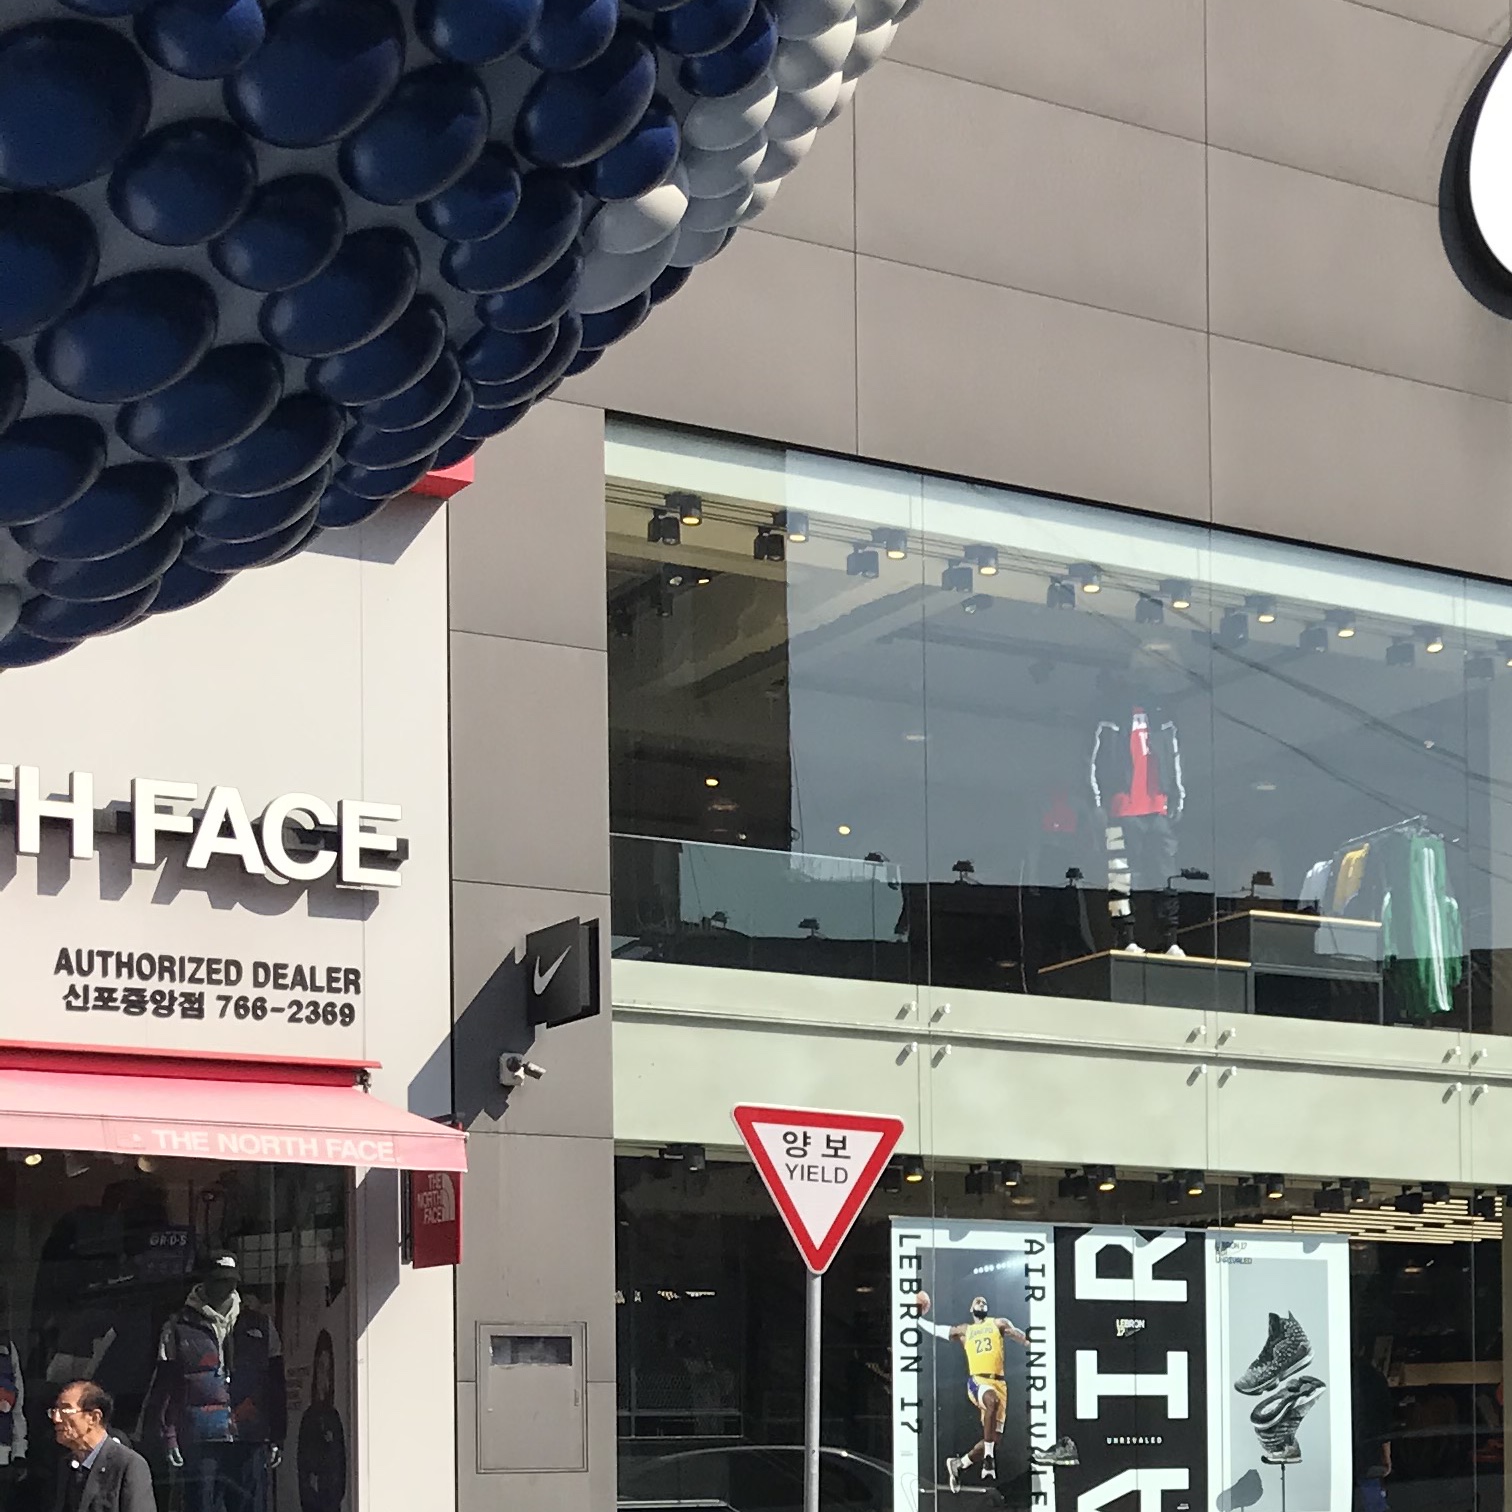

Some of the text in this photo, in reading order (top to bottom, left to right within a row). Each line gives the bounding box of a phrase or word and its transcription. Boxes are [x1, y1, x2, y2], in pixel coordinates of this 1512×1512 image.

[0, 763, 403, 888] H FACE
[54, 947, 361, 995] AUTHORIZED DEALER
[62, 984, 356, 1027] 신포중앙점 766-2369
[152, 1129, 209, 1152] THE
[218, 1133, 318, 1158] NORTH
[785, 1163, 848, 1184] YIELD
[1024, 1239, 1046, 1302] AIR
[899, 1234, 923, 1373] LEBRON
[1116, 1319, 1145, 1328] LEBRON
[975, 1337, 992, 1353] 23
[901, 1397, 923, 1434] 17
